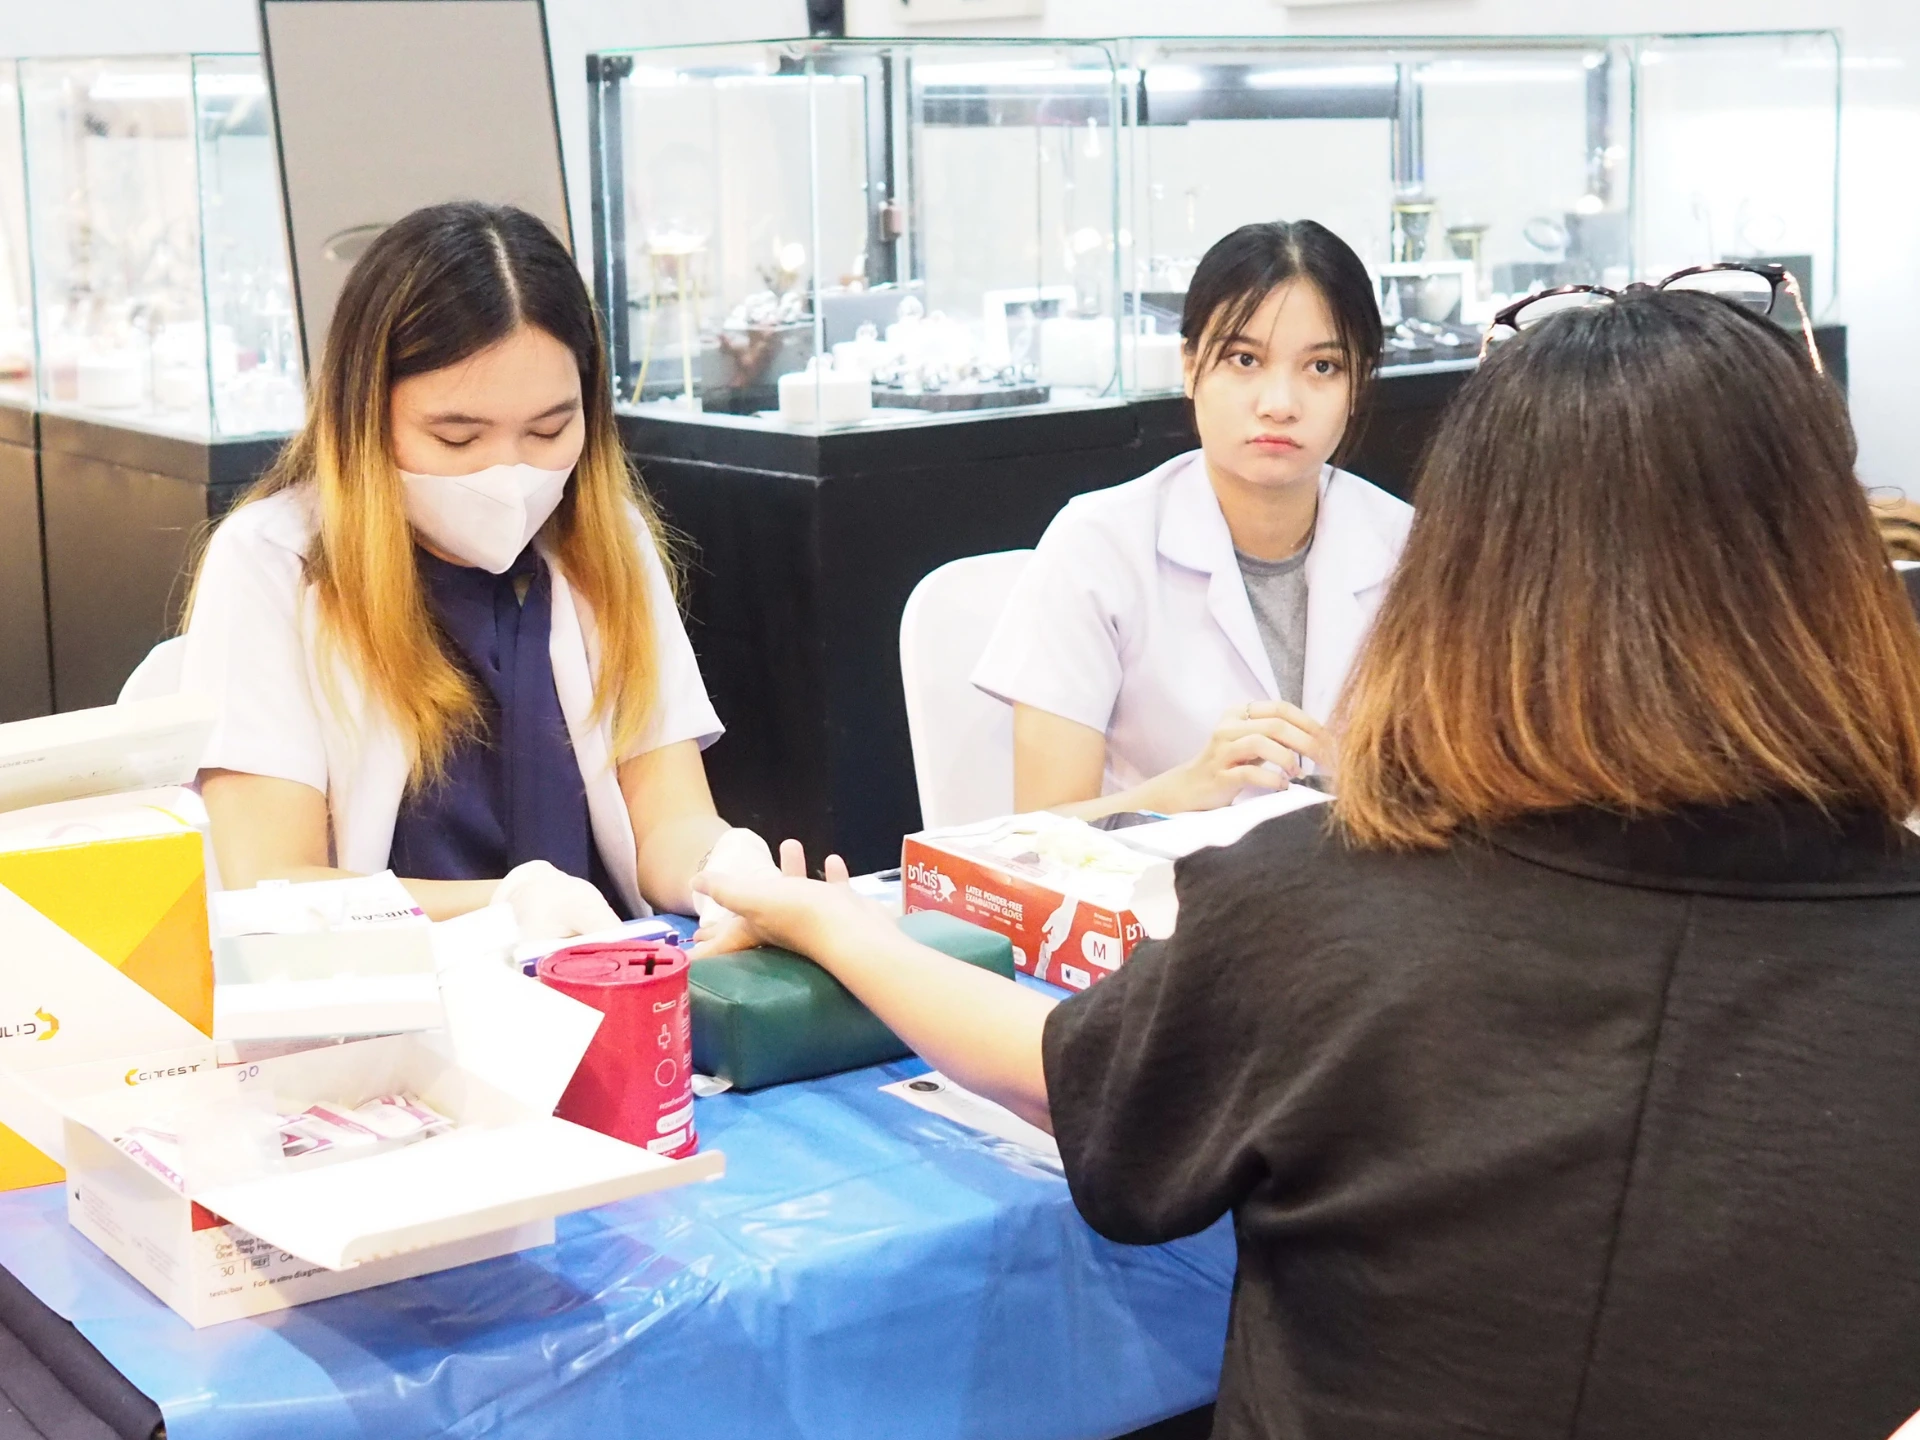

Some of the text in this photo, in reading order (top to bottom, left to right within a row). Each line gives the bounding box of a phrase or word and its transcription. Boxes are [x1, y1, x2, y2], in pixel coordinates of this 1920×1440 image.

[965, 884, 1023, 912] LATEX POWDER-FREE
[965, 893, 1000, 912] EXAMINATION
[1001, 907, 1023, 921] GLOVES
[1093, 940, 1106, 960] M
[221, 1265, 235, 1277] 30
[253, 1279, 268, 1288] For
